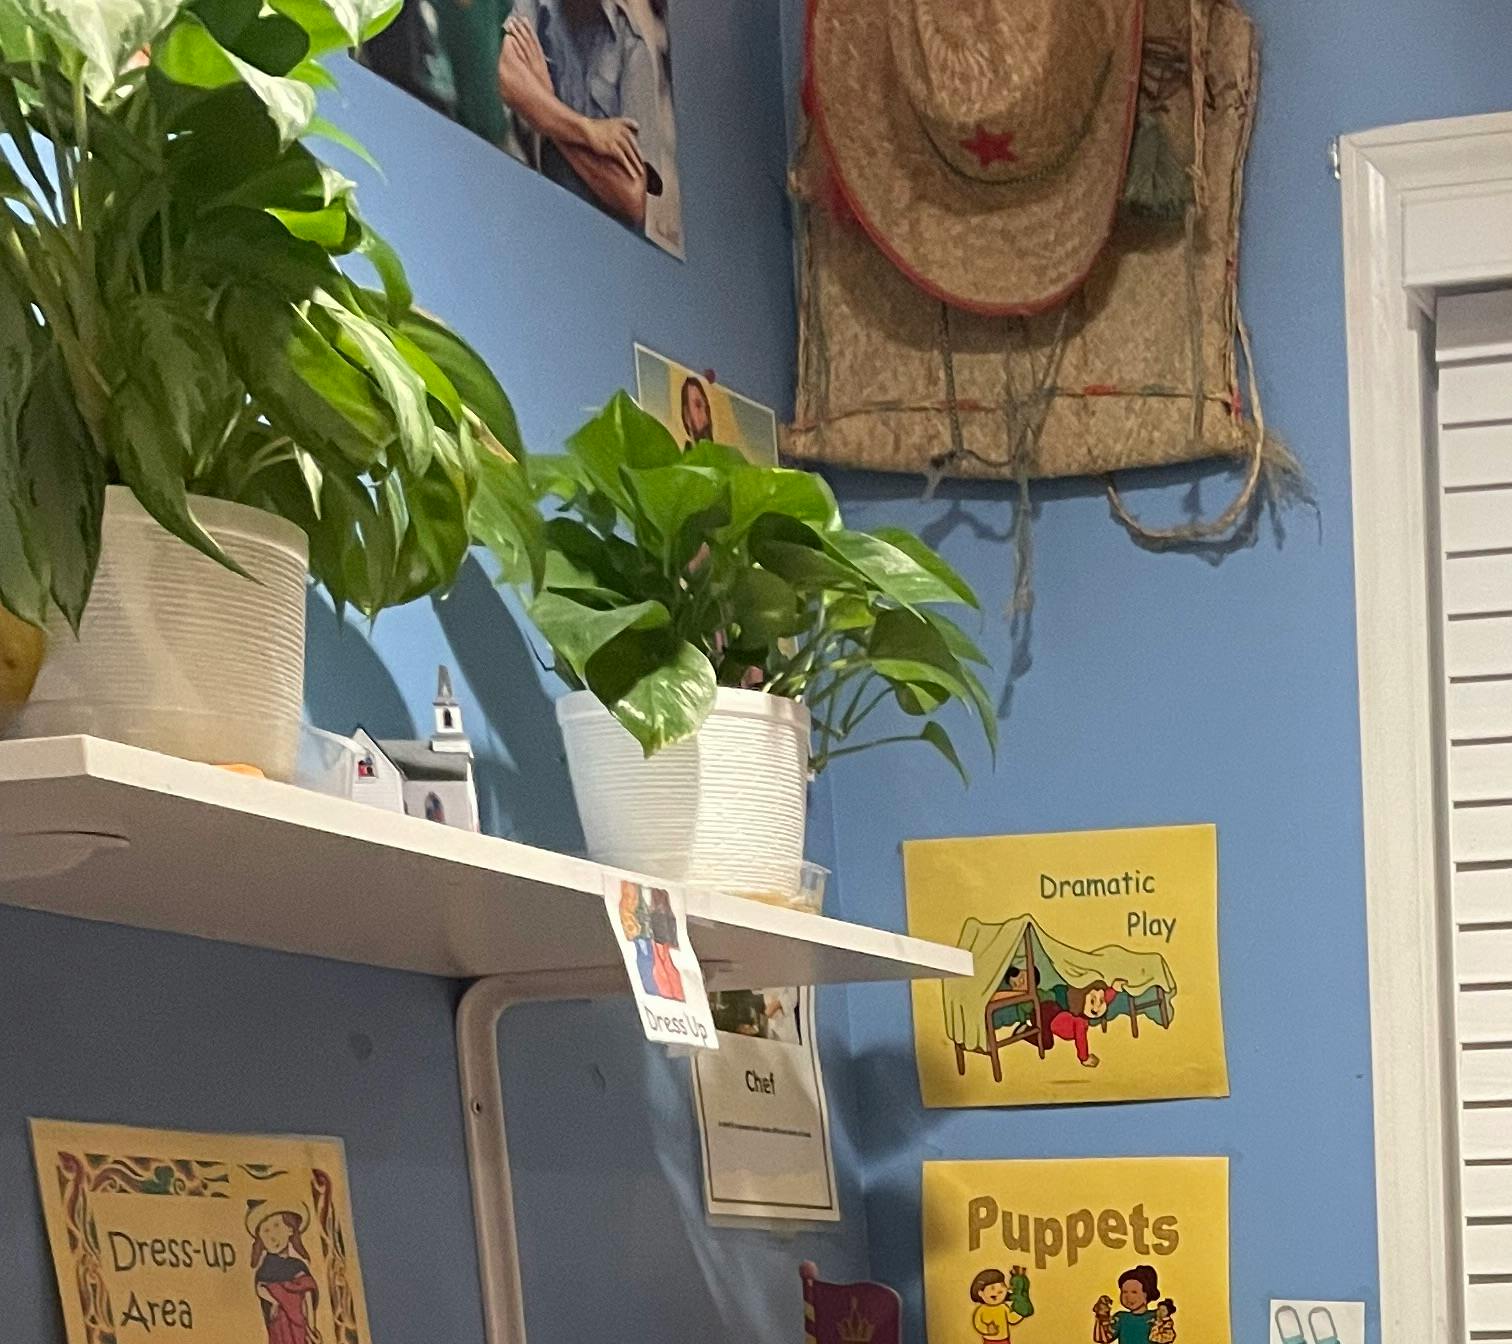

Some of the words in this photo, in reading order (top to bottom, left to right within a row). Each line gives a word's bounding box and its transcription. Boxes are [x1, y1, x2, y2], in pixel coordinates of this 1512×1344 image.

[1039, 871, 1156, 900] Dramatic
[1127, 910, 1177, 942] Play
[643, 1005, 688, 1036] Dress
[682, 1012, 708, 1048] Up
[745, 1069, 776, 1097] Chef
[107, 1230, 237, 1274] Dress-up
[967, 1194, 1180, 1270] Puppets
[120, 1290, 194, 1333] Area
